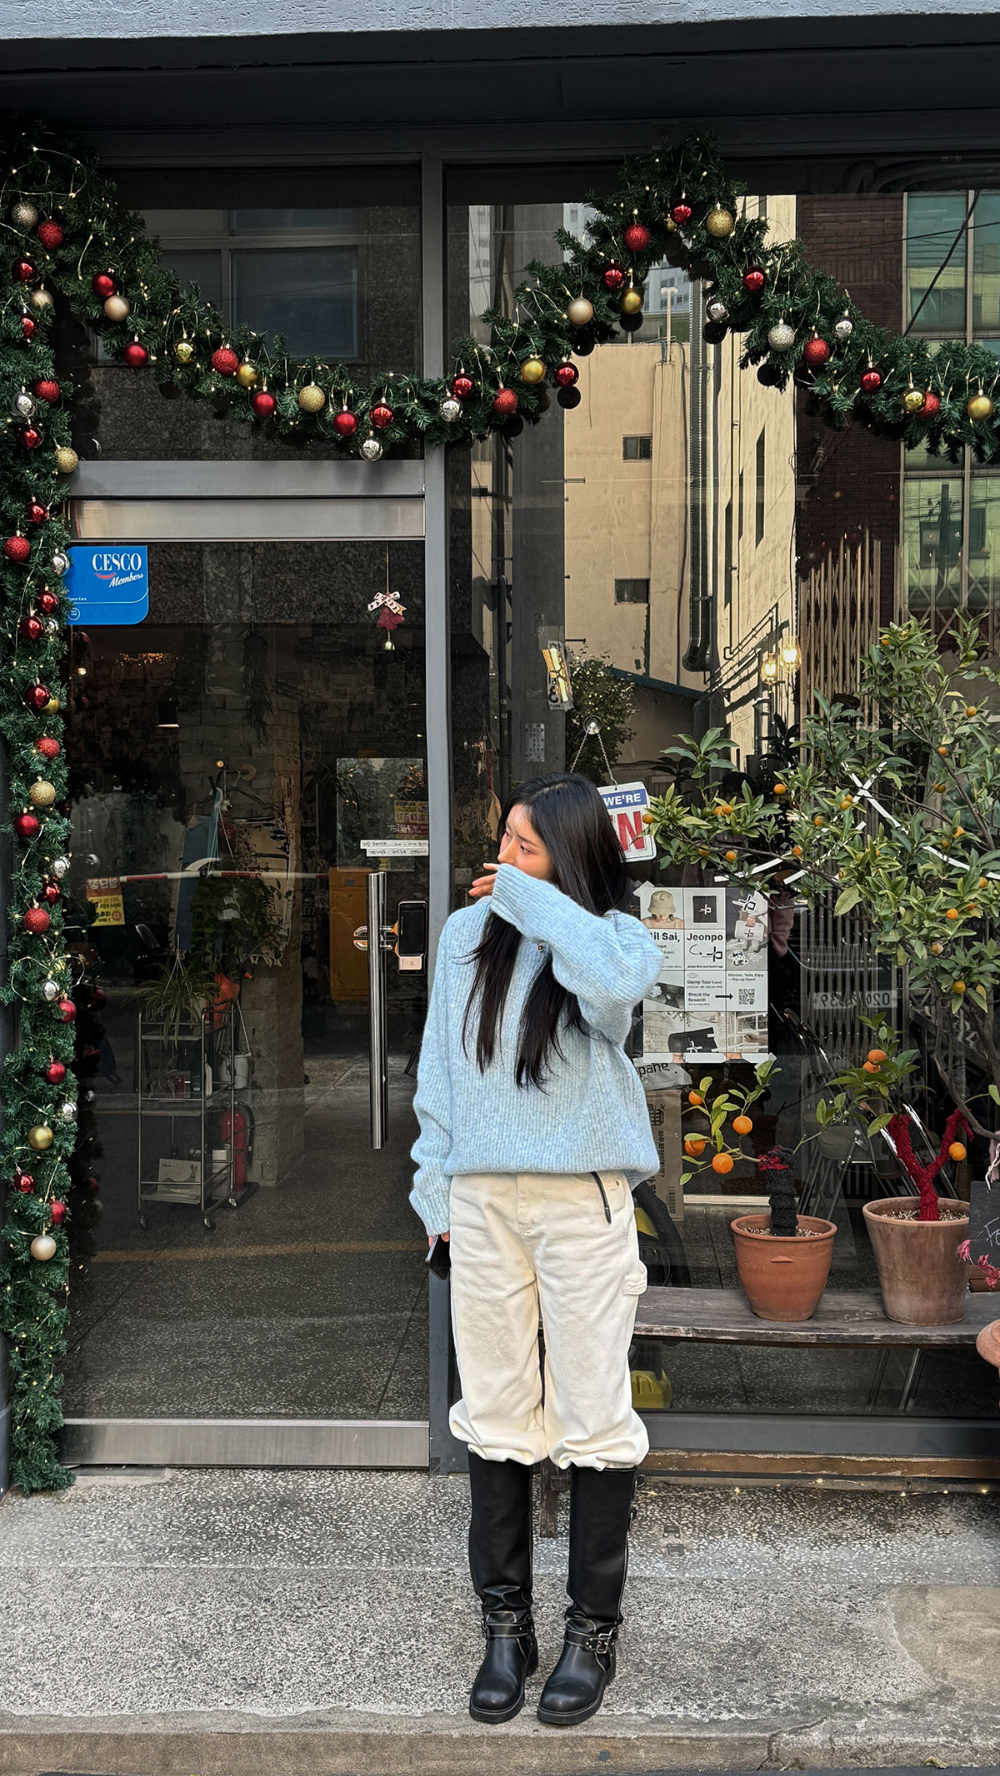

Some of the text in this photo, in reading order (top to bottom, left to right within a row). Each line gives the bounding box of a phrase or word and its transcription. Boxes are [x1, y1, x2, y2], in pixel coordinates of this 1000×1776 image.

[92, 552, 142, 571] CESCO
[108, 572, 144, 588] Members
[603, 792, 642, 806] WE'RE
[661, 932, 681, 943] Sai,
[686, 932, 724, 943] Jeonpo
